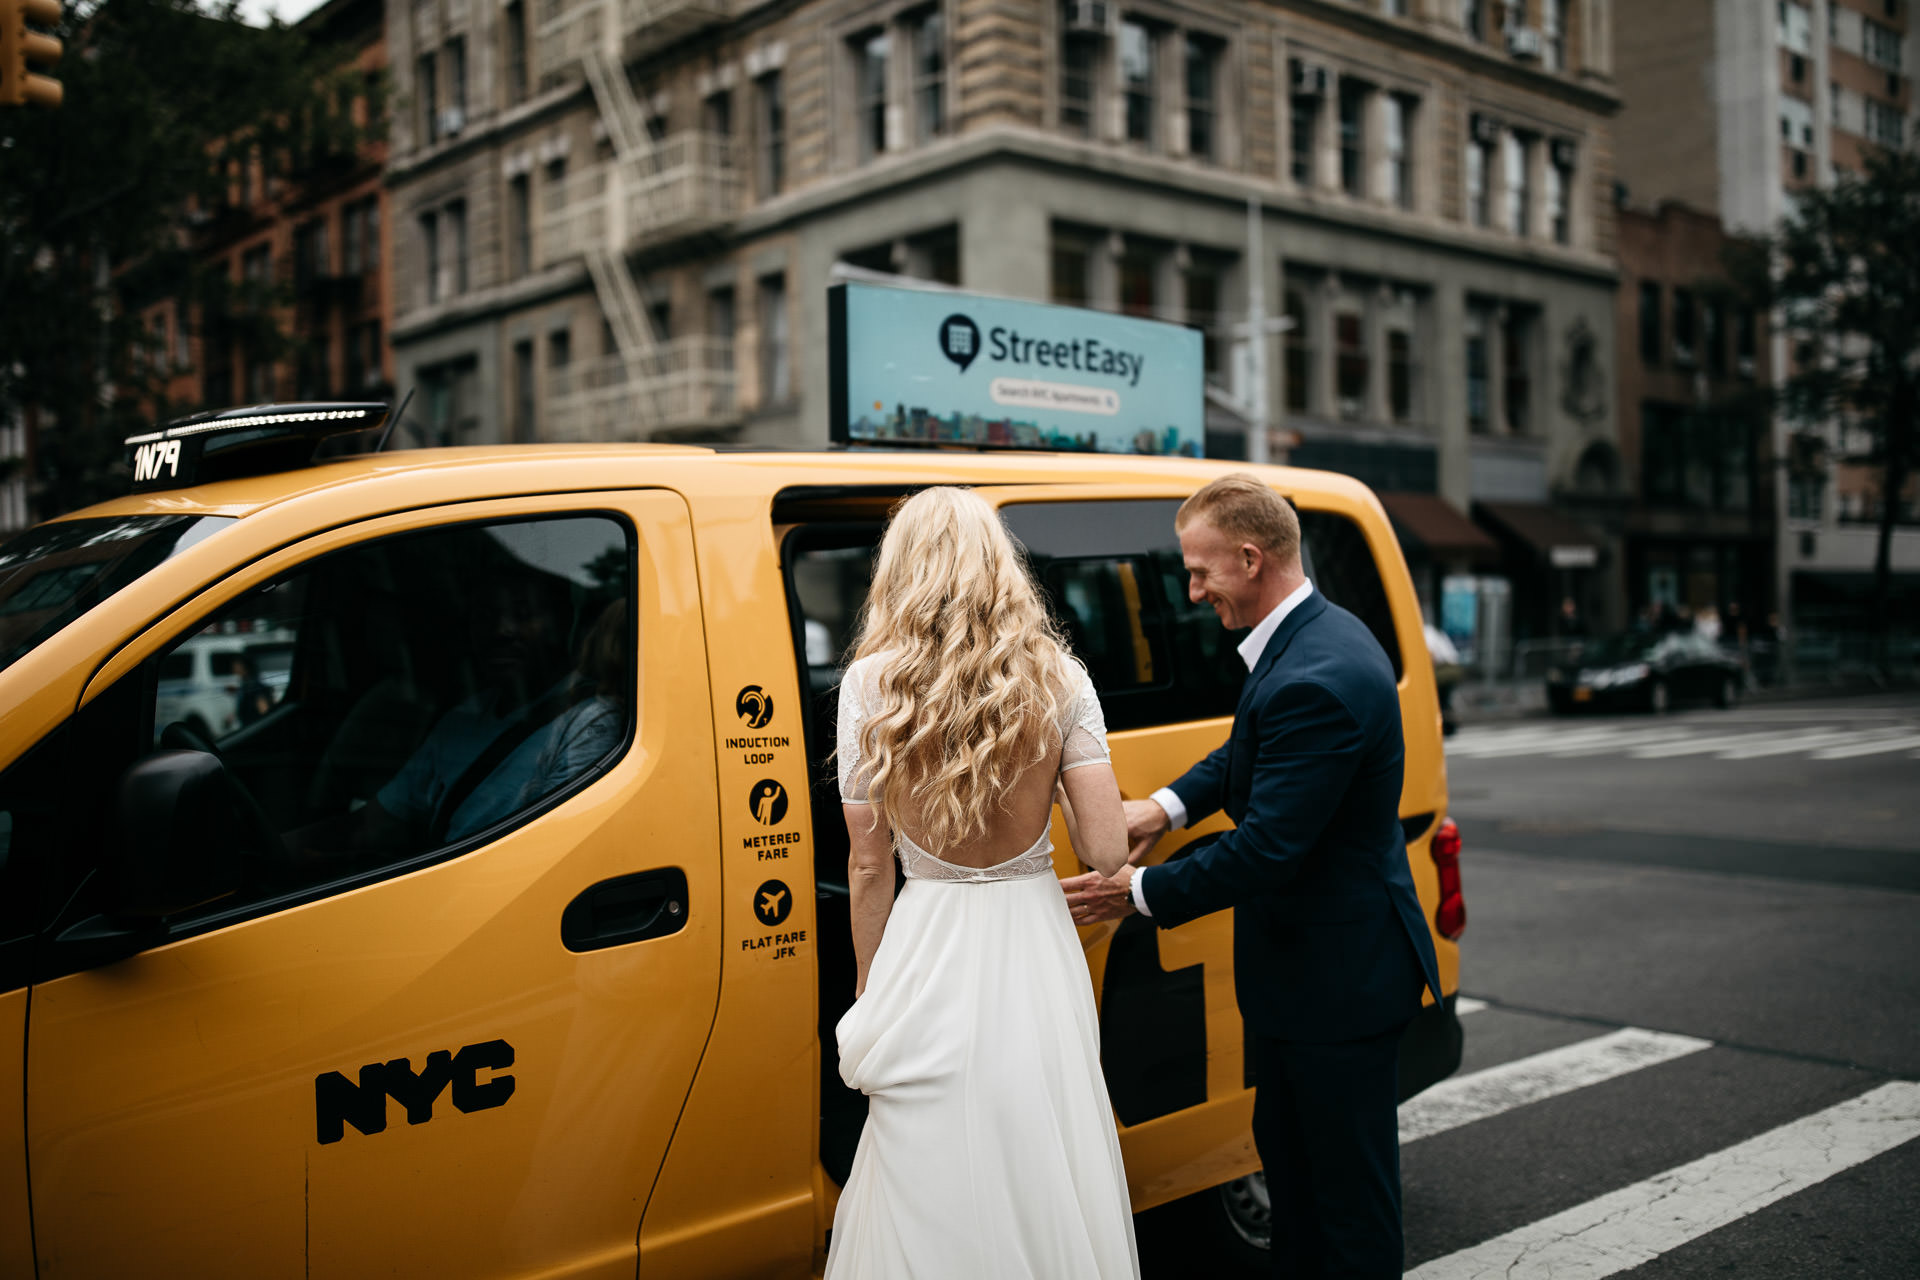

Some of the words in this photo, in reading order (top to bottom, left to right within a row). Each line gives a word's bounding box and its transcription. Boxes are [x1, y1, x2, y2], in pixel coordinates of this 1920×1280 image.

[989, 327, 1143, 387] StreetEasy
[134, 439, 182, 482] 1N79
[725, 736, 790, 749] INDUCTION
[743, 753, 775, 765] LOOP
[743, 831, 801, 849] METERED
[757, 847, 789, 862] FARE
[741, 935, 773, 952] FLAT
[775, 930, 807, 946] FARE
[772, 945, 797, 961] JFK
[315, 1038, 516, 1146] NYC
